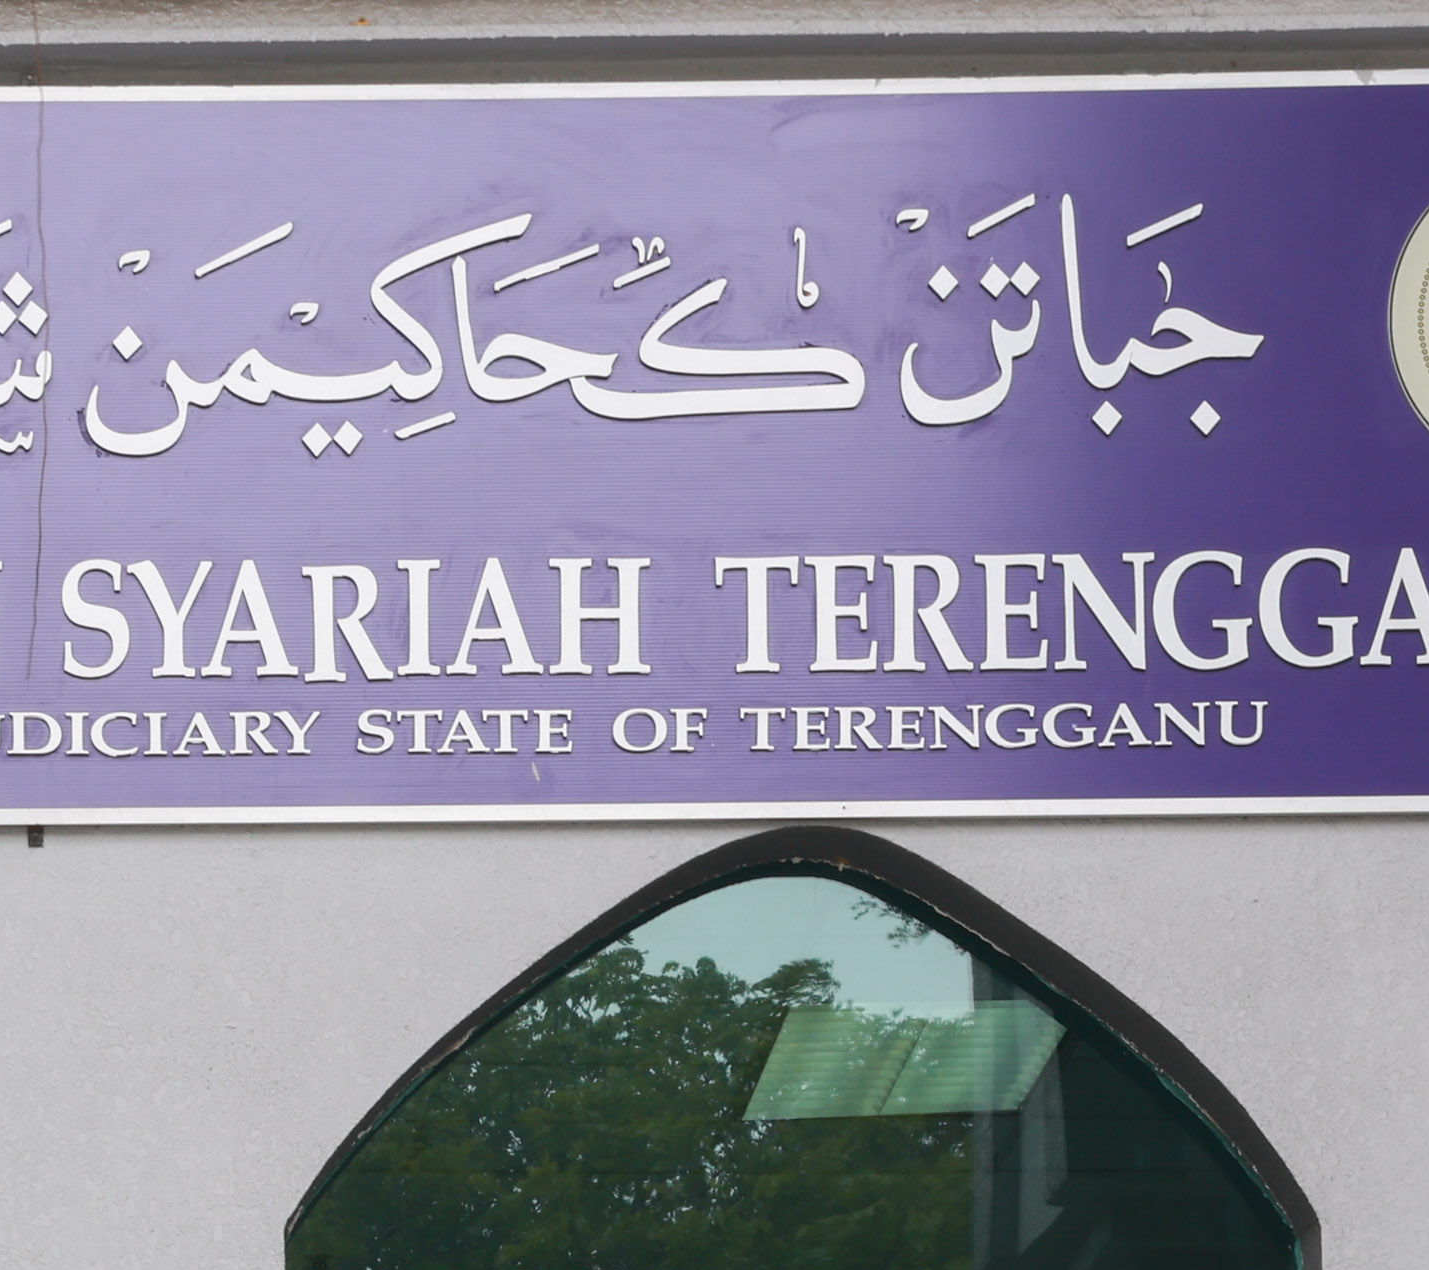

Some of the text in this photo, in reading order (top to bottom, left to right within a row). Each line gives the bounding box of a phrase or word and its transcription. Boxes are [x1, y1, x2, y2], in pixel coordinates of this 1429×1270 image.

[61, 556, 651, 683] SYARIAH
[356, 708, 573, 754] STATE
[612, 707, 708, 753] OF
[739, 701, 1269, 751] TERENGGANU
